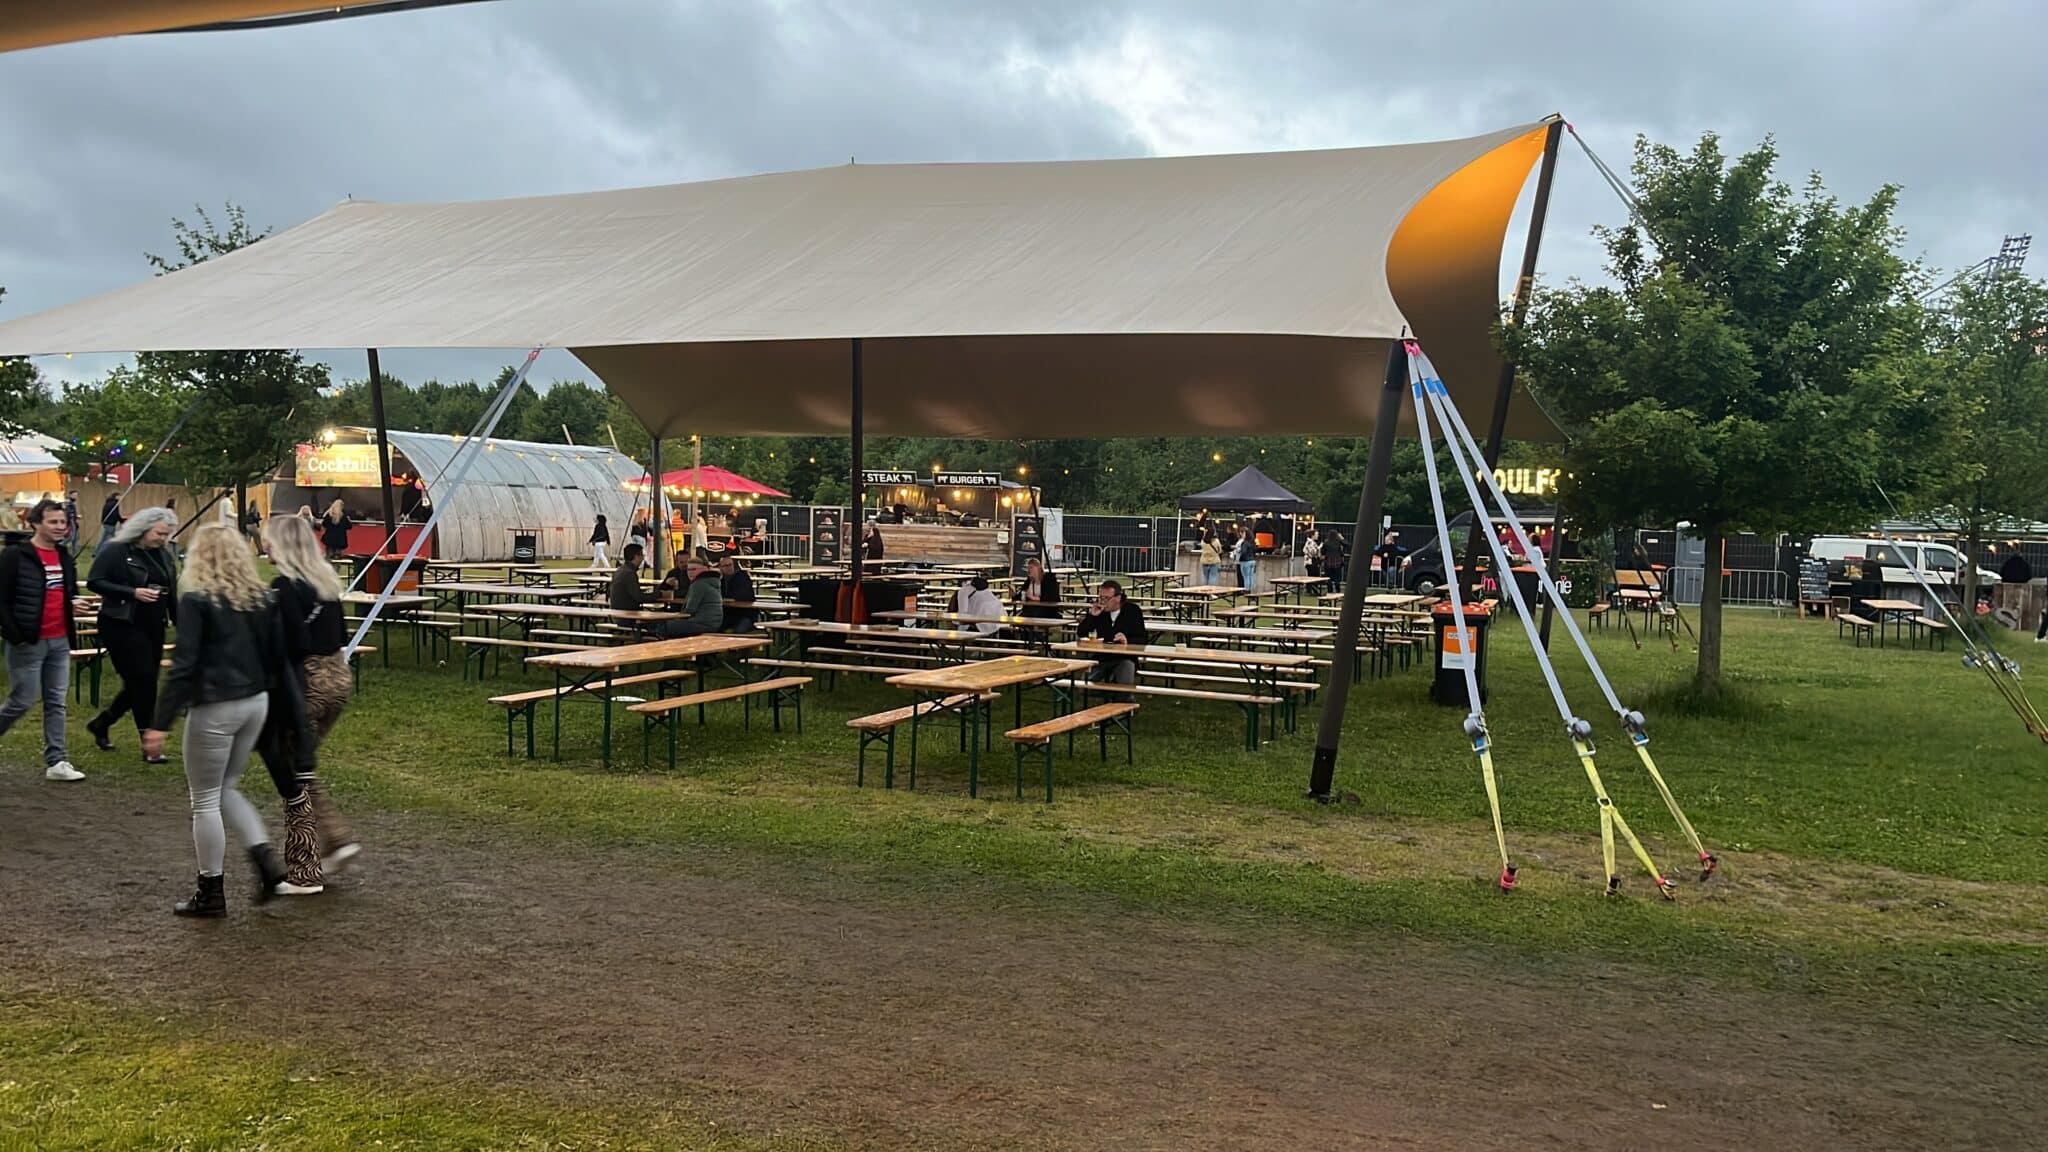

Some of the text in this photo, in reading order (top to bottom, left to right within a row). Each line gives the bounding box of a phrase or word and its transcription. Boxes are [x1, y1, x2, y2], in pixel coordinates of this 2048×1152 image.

[308, 455, 377, 472] Cocktails
[866, 473, 901, 483] STEAK
[949, 476, 985, 484] BURGER
